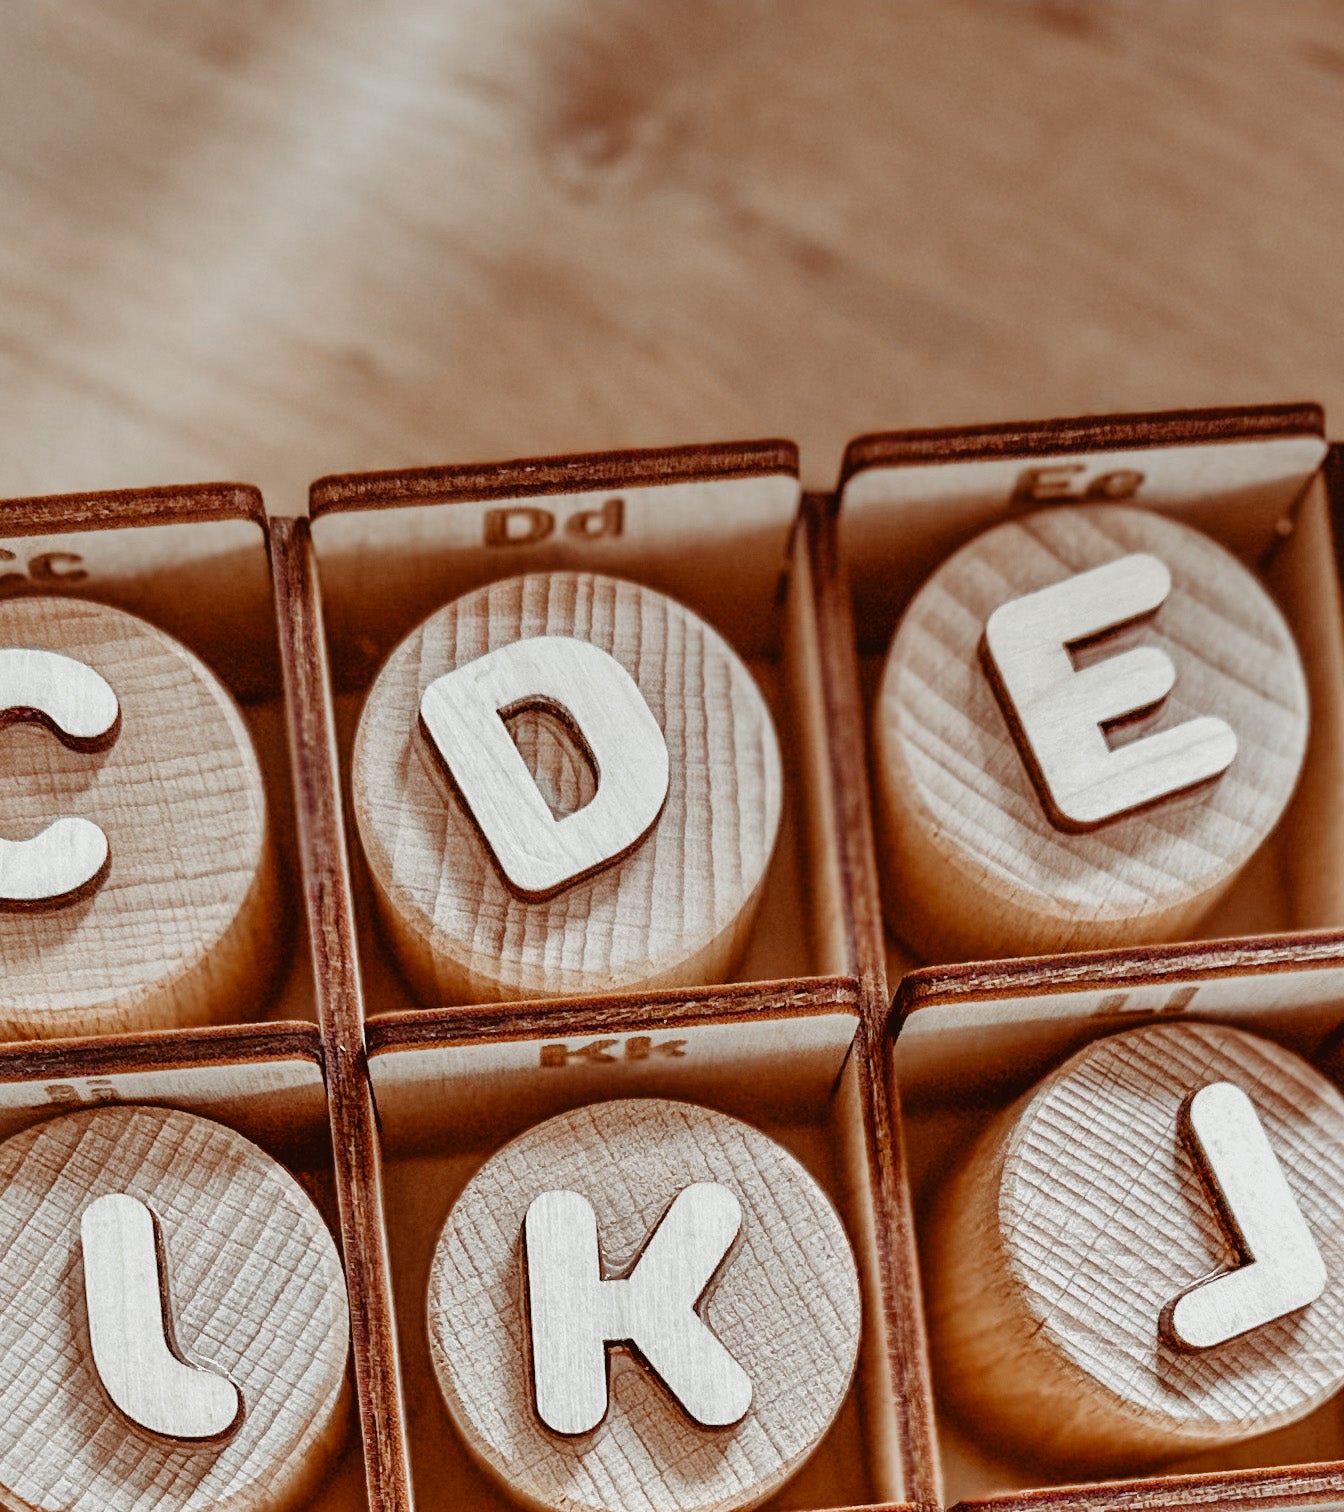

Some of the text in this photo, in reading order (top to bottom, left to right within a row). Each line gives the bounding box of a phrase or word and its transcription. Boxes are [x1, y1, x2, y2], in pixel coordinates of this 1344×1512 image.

[483, 496, 626, 547] Dd
[1010, 463, 1146, 505] Ee
[419, 635, 669, 894] D
[984, 551, 1239, 824] E
[525, 1181, 754, 1435] K
